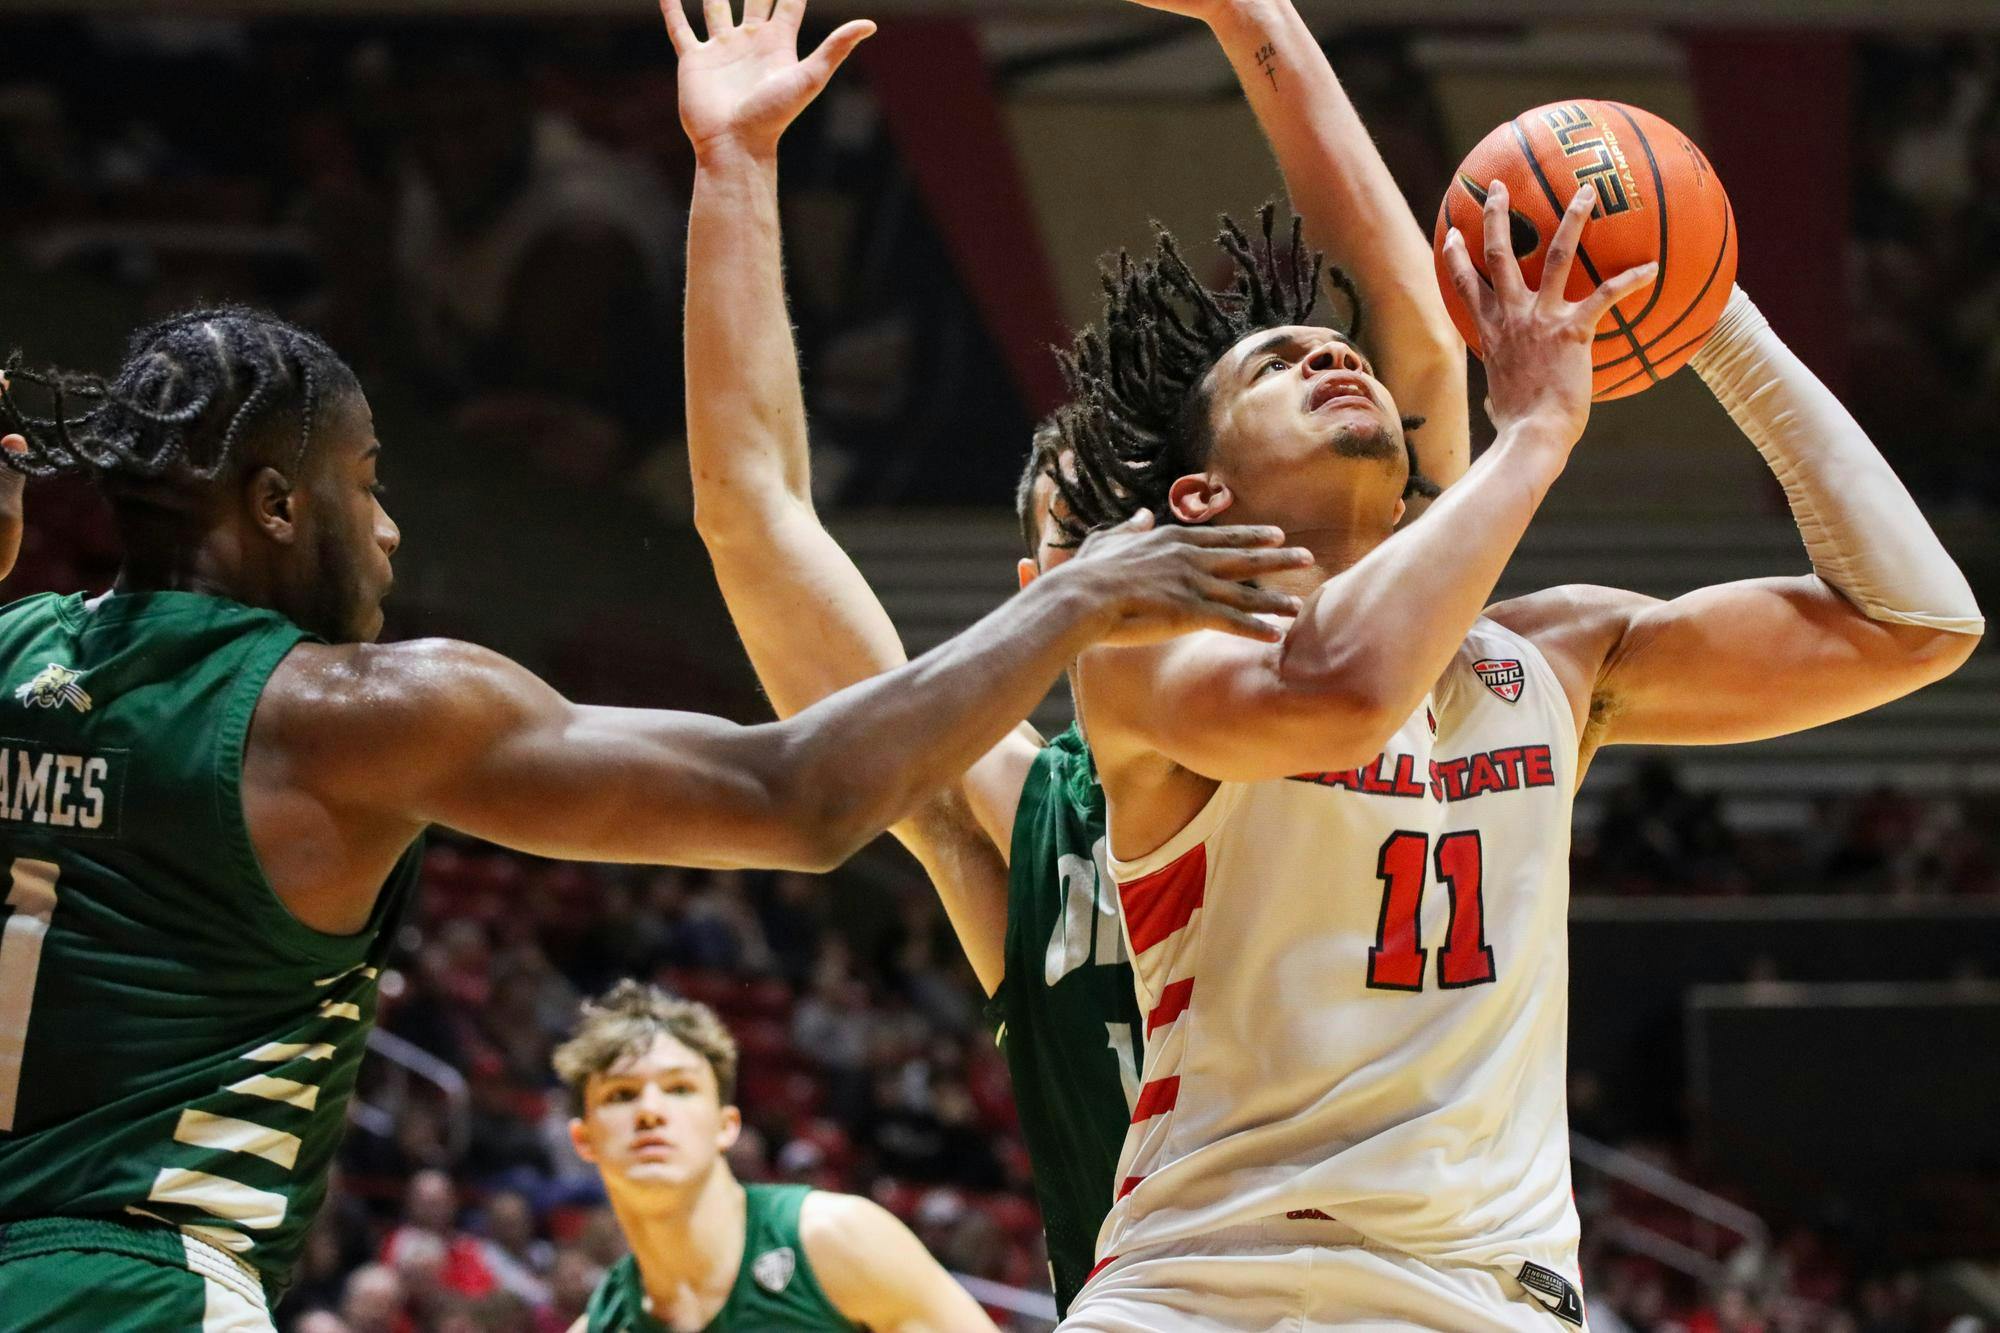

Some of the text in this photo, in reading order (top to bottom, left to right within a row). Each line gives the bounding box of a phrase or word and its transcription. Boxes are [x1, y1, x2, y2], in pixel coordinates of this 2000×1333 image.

[1255, 42, 1276, 66] 126
[1541, 103, 1630, 221] ELITE
[1481, 668, 1524, 685] MAC
[1429, 744, 1555, 803] STATE
[1366, 829, 1496, 992] 11
[1569, 1294, 1577, 1311] L
